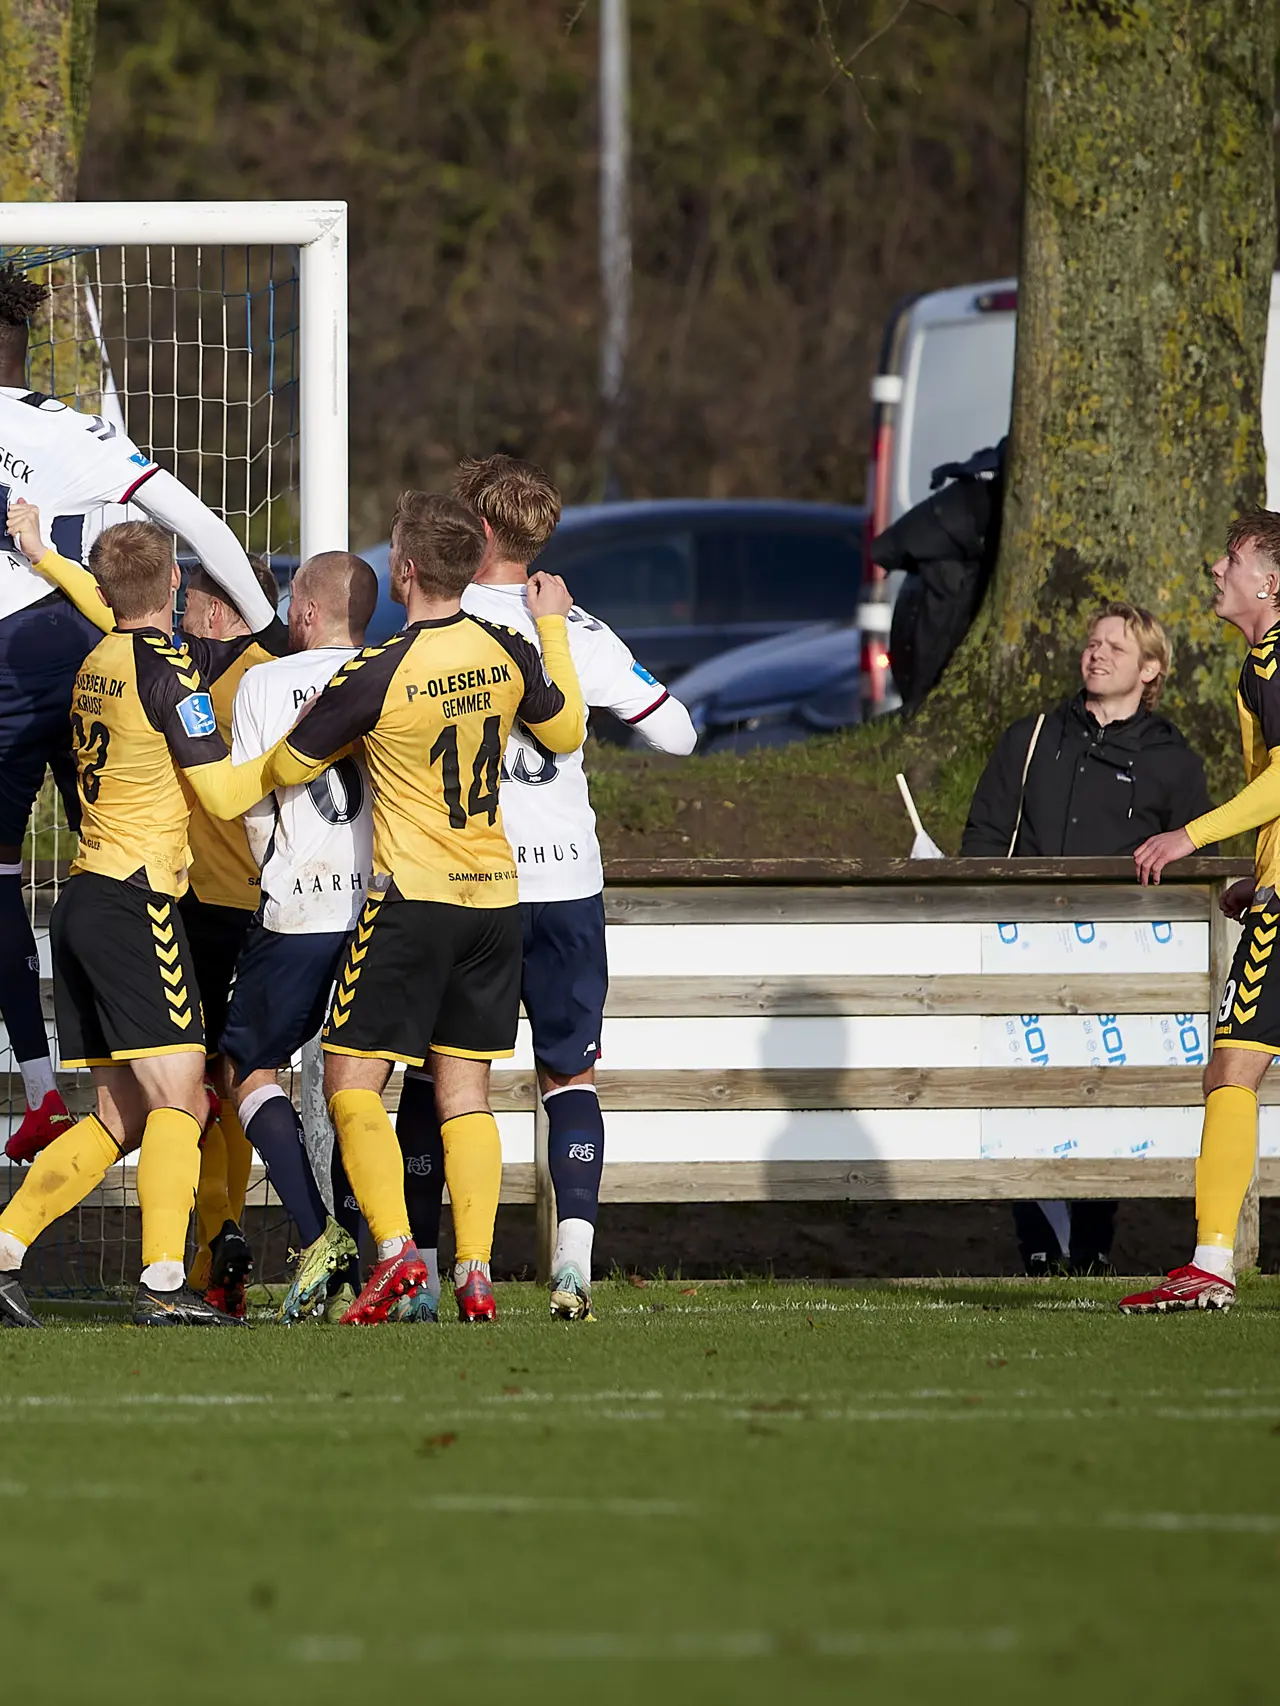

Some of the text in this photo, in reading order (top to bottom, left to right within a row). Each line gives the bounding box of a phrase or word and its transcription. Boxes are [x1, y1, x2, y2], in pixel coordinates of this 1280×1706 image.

[405, 663, 512, 703] P-OLESEN.DK
[442, 691, 492, 719] GEMMER
[429, 715, 501, 829] 14
[448, 872, 492, 881] SAMMEN
[494, 872, 503, 881] ER
